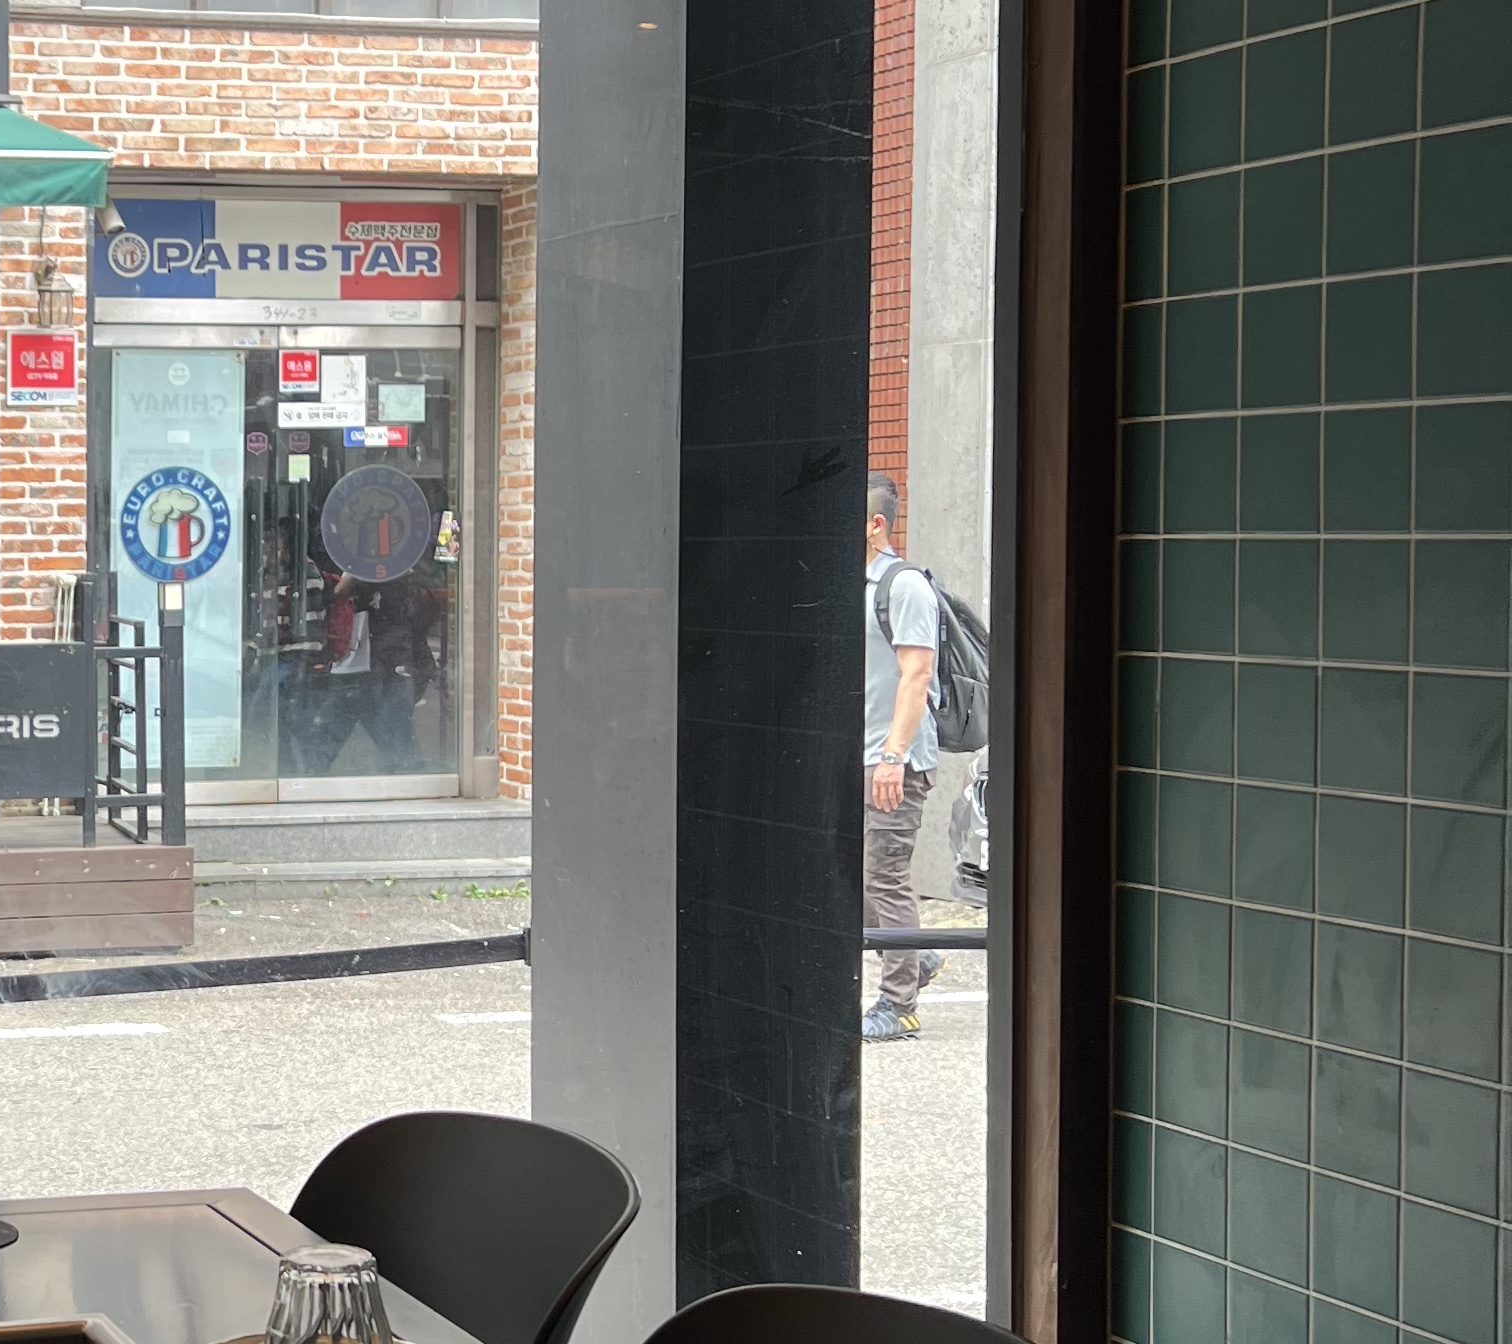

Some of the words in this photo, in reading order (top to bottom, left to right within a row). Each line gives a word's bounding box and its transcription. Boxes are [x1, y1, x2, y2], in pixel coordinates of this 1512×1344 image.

[345, 221, 440, 241] 수제맥주전문점
[154, 239, 441, 276] PARISTAR
[20, 350, 64, 370] 에스원
[11, 391, 47, 401] SECOM
